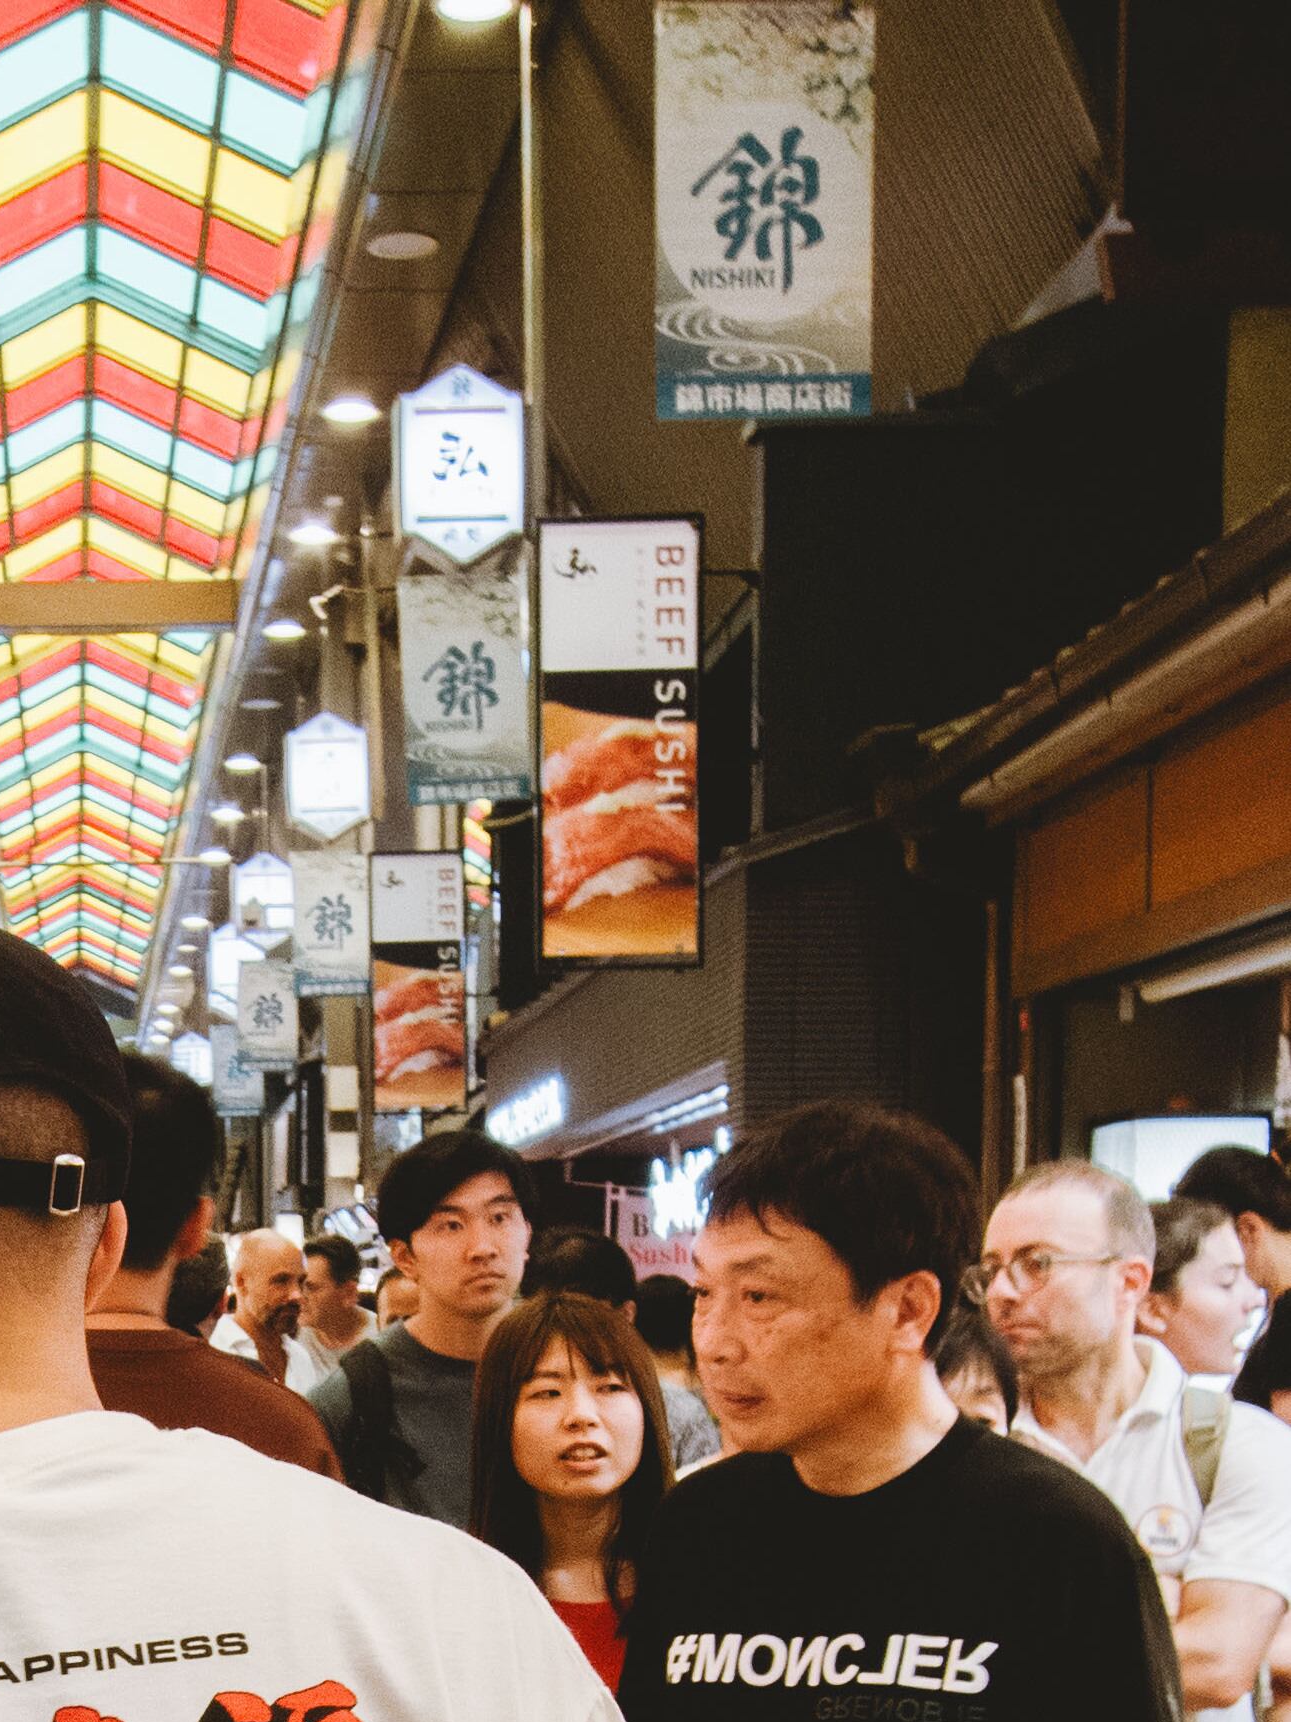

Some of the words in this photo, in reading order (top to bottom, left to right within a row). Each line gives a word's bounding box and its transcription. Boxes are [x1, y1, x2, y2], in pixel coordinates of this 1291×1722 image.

[691, 126, 825, 296] 錦
[690, 266, 776, 289] NISHIKI
[655, 545, 685, 655] BEEF
[422, 641, 500, 733] 錦
[654, 678, 687, 813] SUSHI
